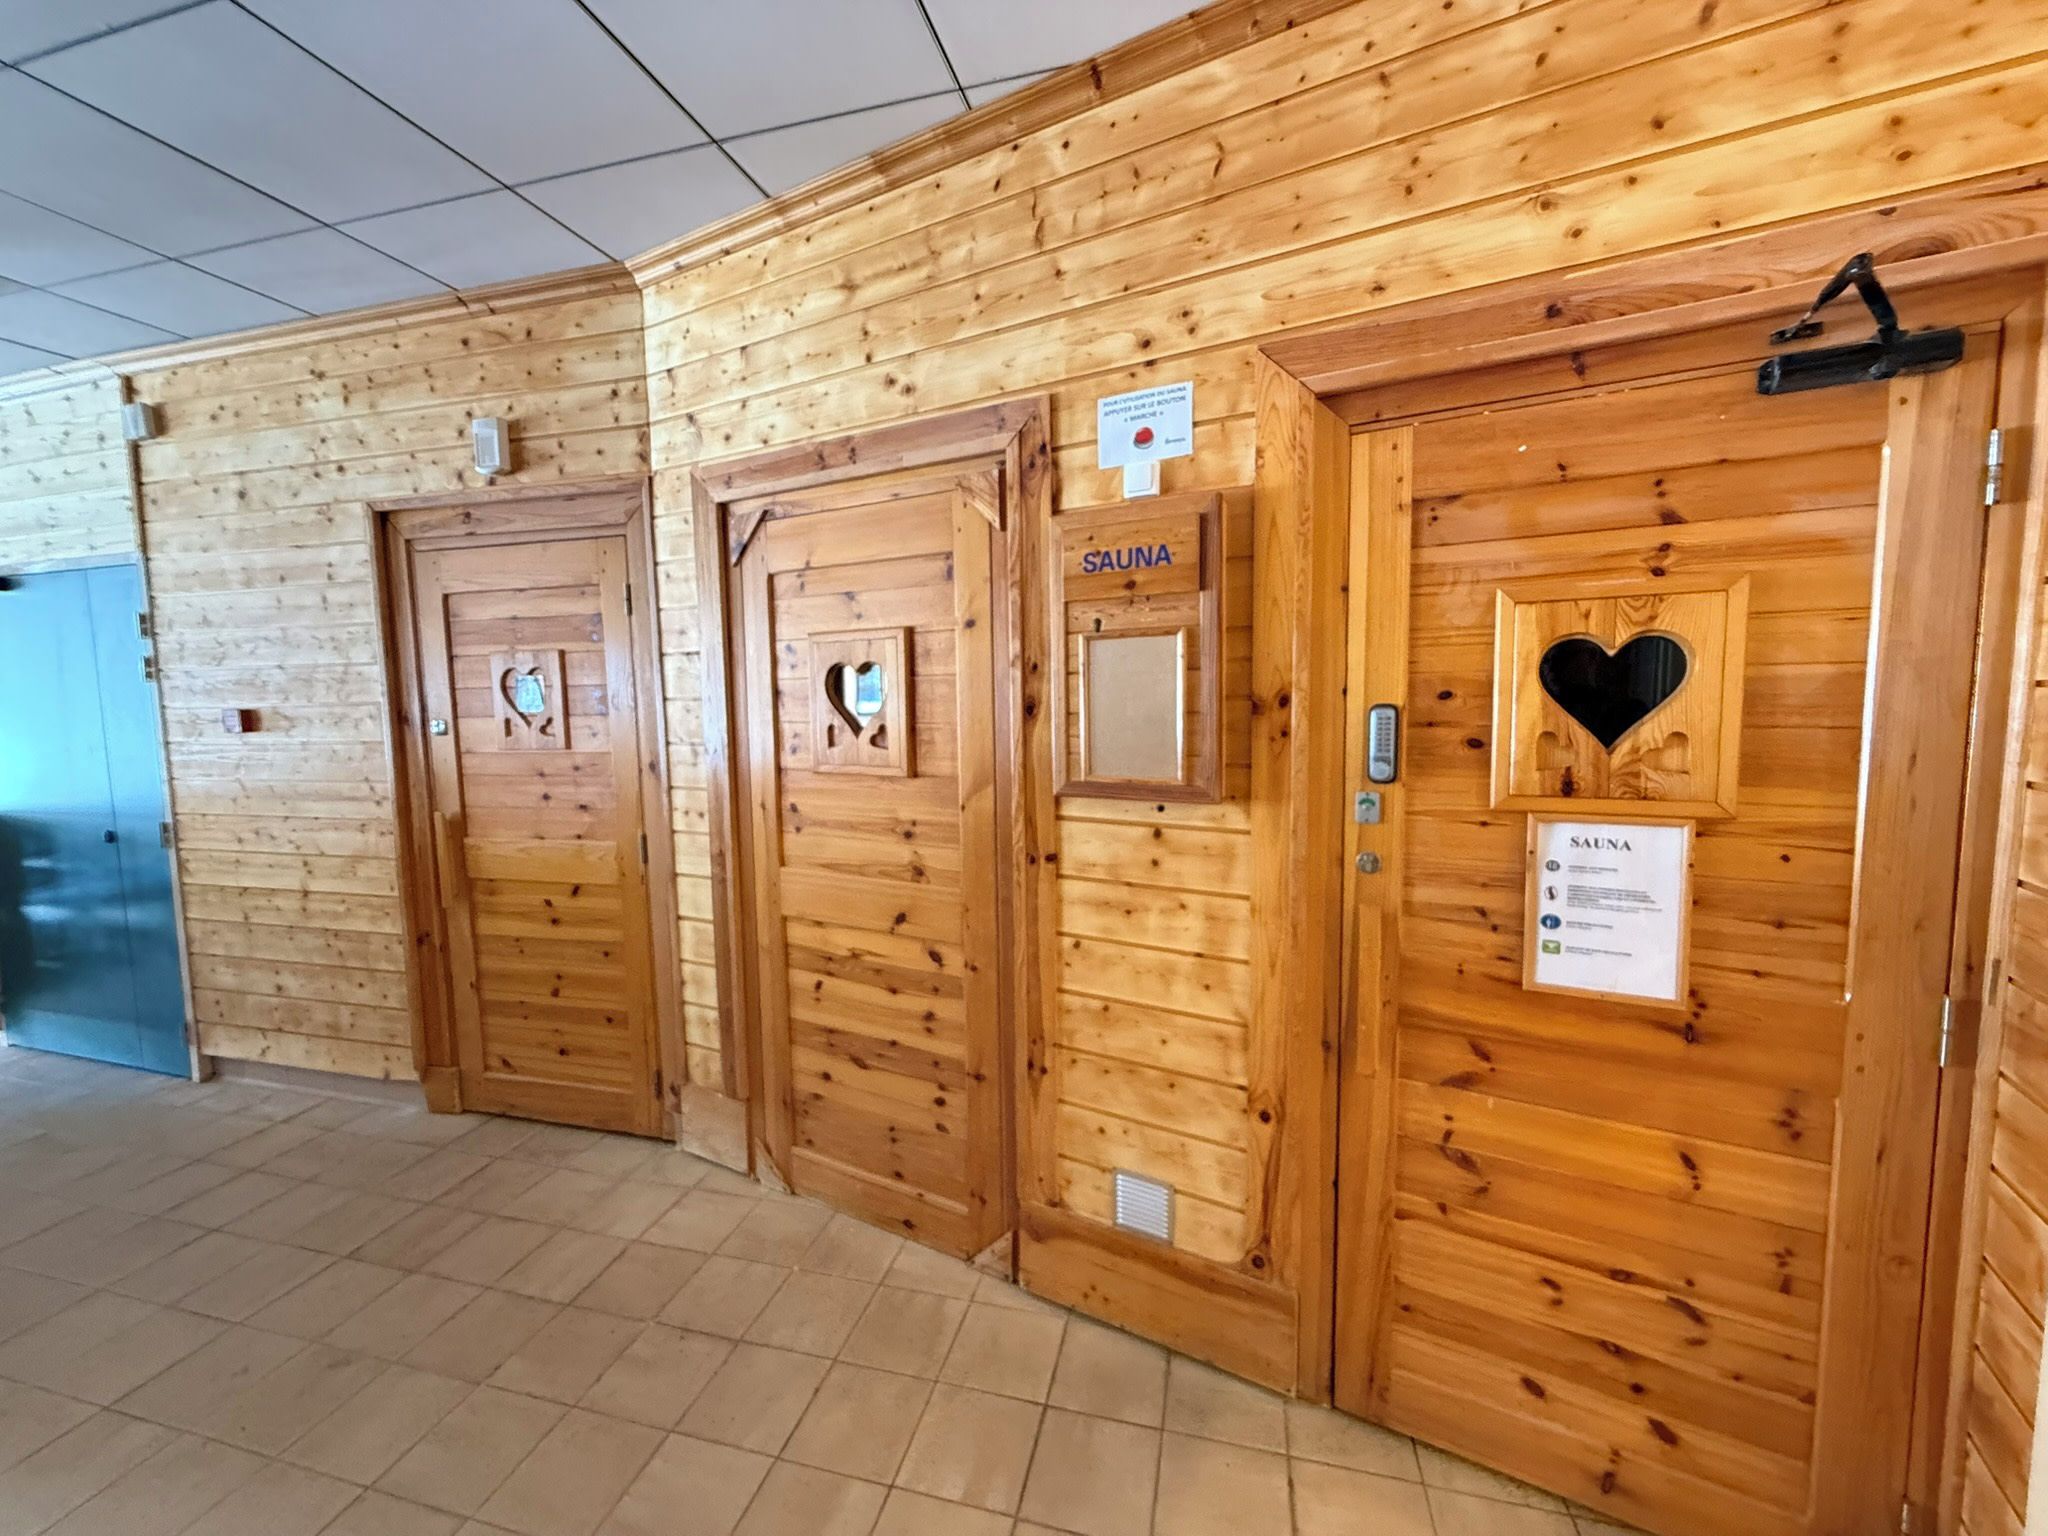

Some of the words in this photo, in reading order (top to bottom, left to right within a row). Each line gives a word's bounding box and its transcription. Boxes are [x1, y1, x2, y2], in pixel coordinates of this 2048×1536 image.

[1166, 385, 1187, 394] SAUNA
[1103, 405, 1132, 417] APPUYER
[1133, 402, 1147, 411] SUR
[1148, 400, 1155, 409] LE
[1157, 395, 1187, 407] BOUTON
[1129, 411, 1158, 422] MARCHE
[1083, 543, 1172, 574] SAUNA
[1570, 836, 1632, 852] SAUNA
